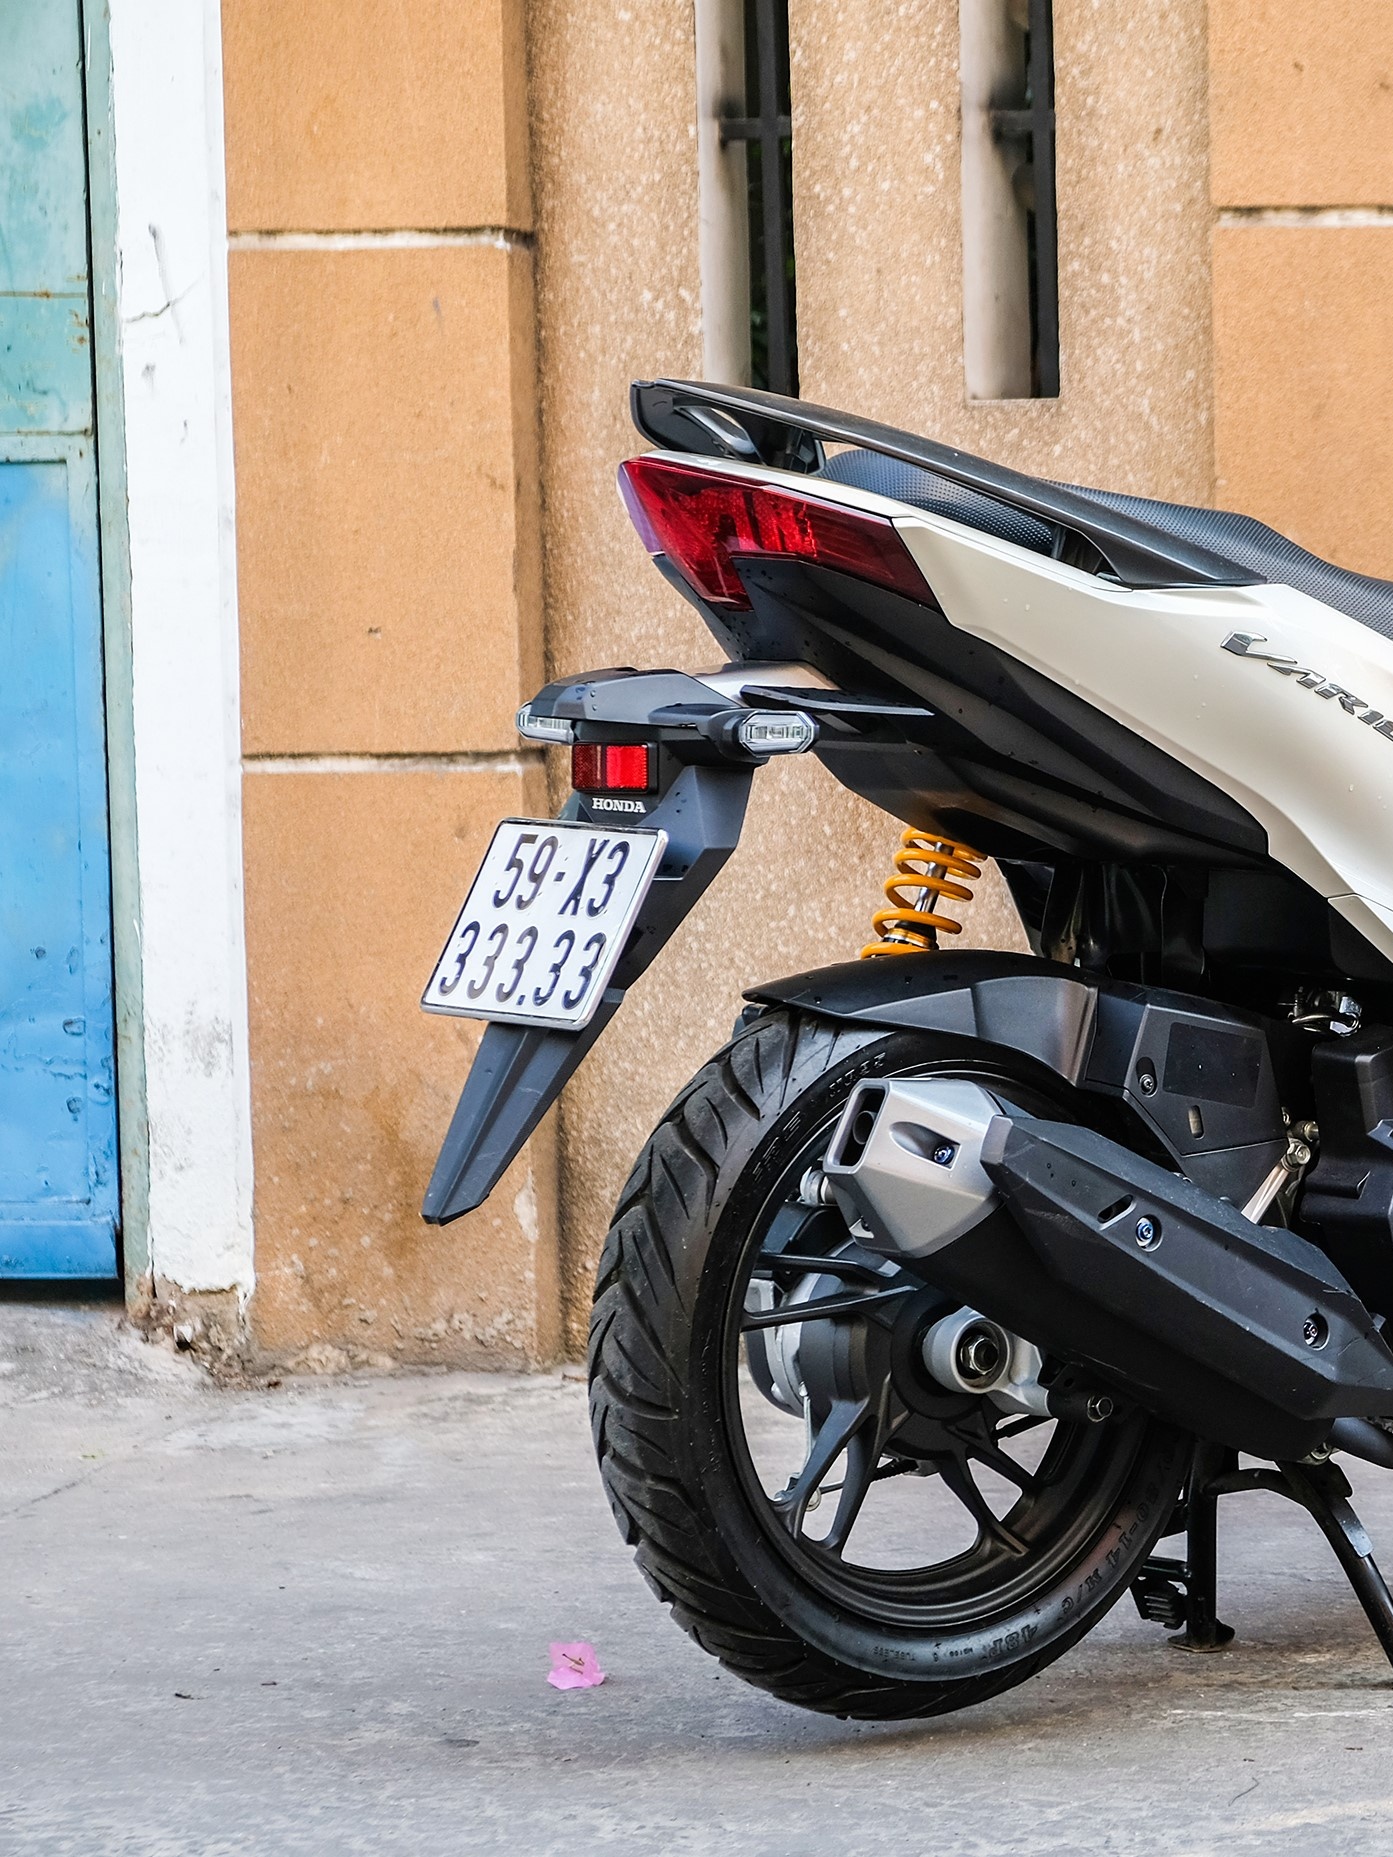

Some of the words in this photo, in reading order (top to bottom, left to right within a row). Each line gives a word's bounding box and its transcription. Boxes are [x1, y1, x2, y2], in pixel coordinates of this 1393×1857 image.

[592, 797, 646, 814] HONDA
[492, 833, 631, 917] 59-X3
[437, 920, 607, 1011] 333.33
